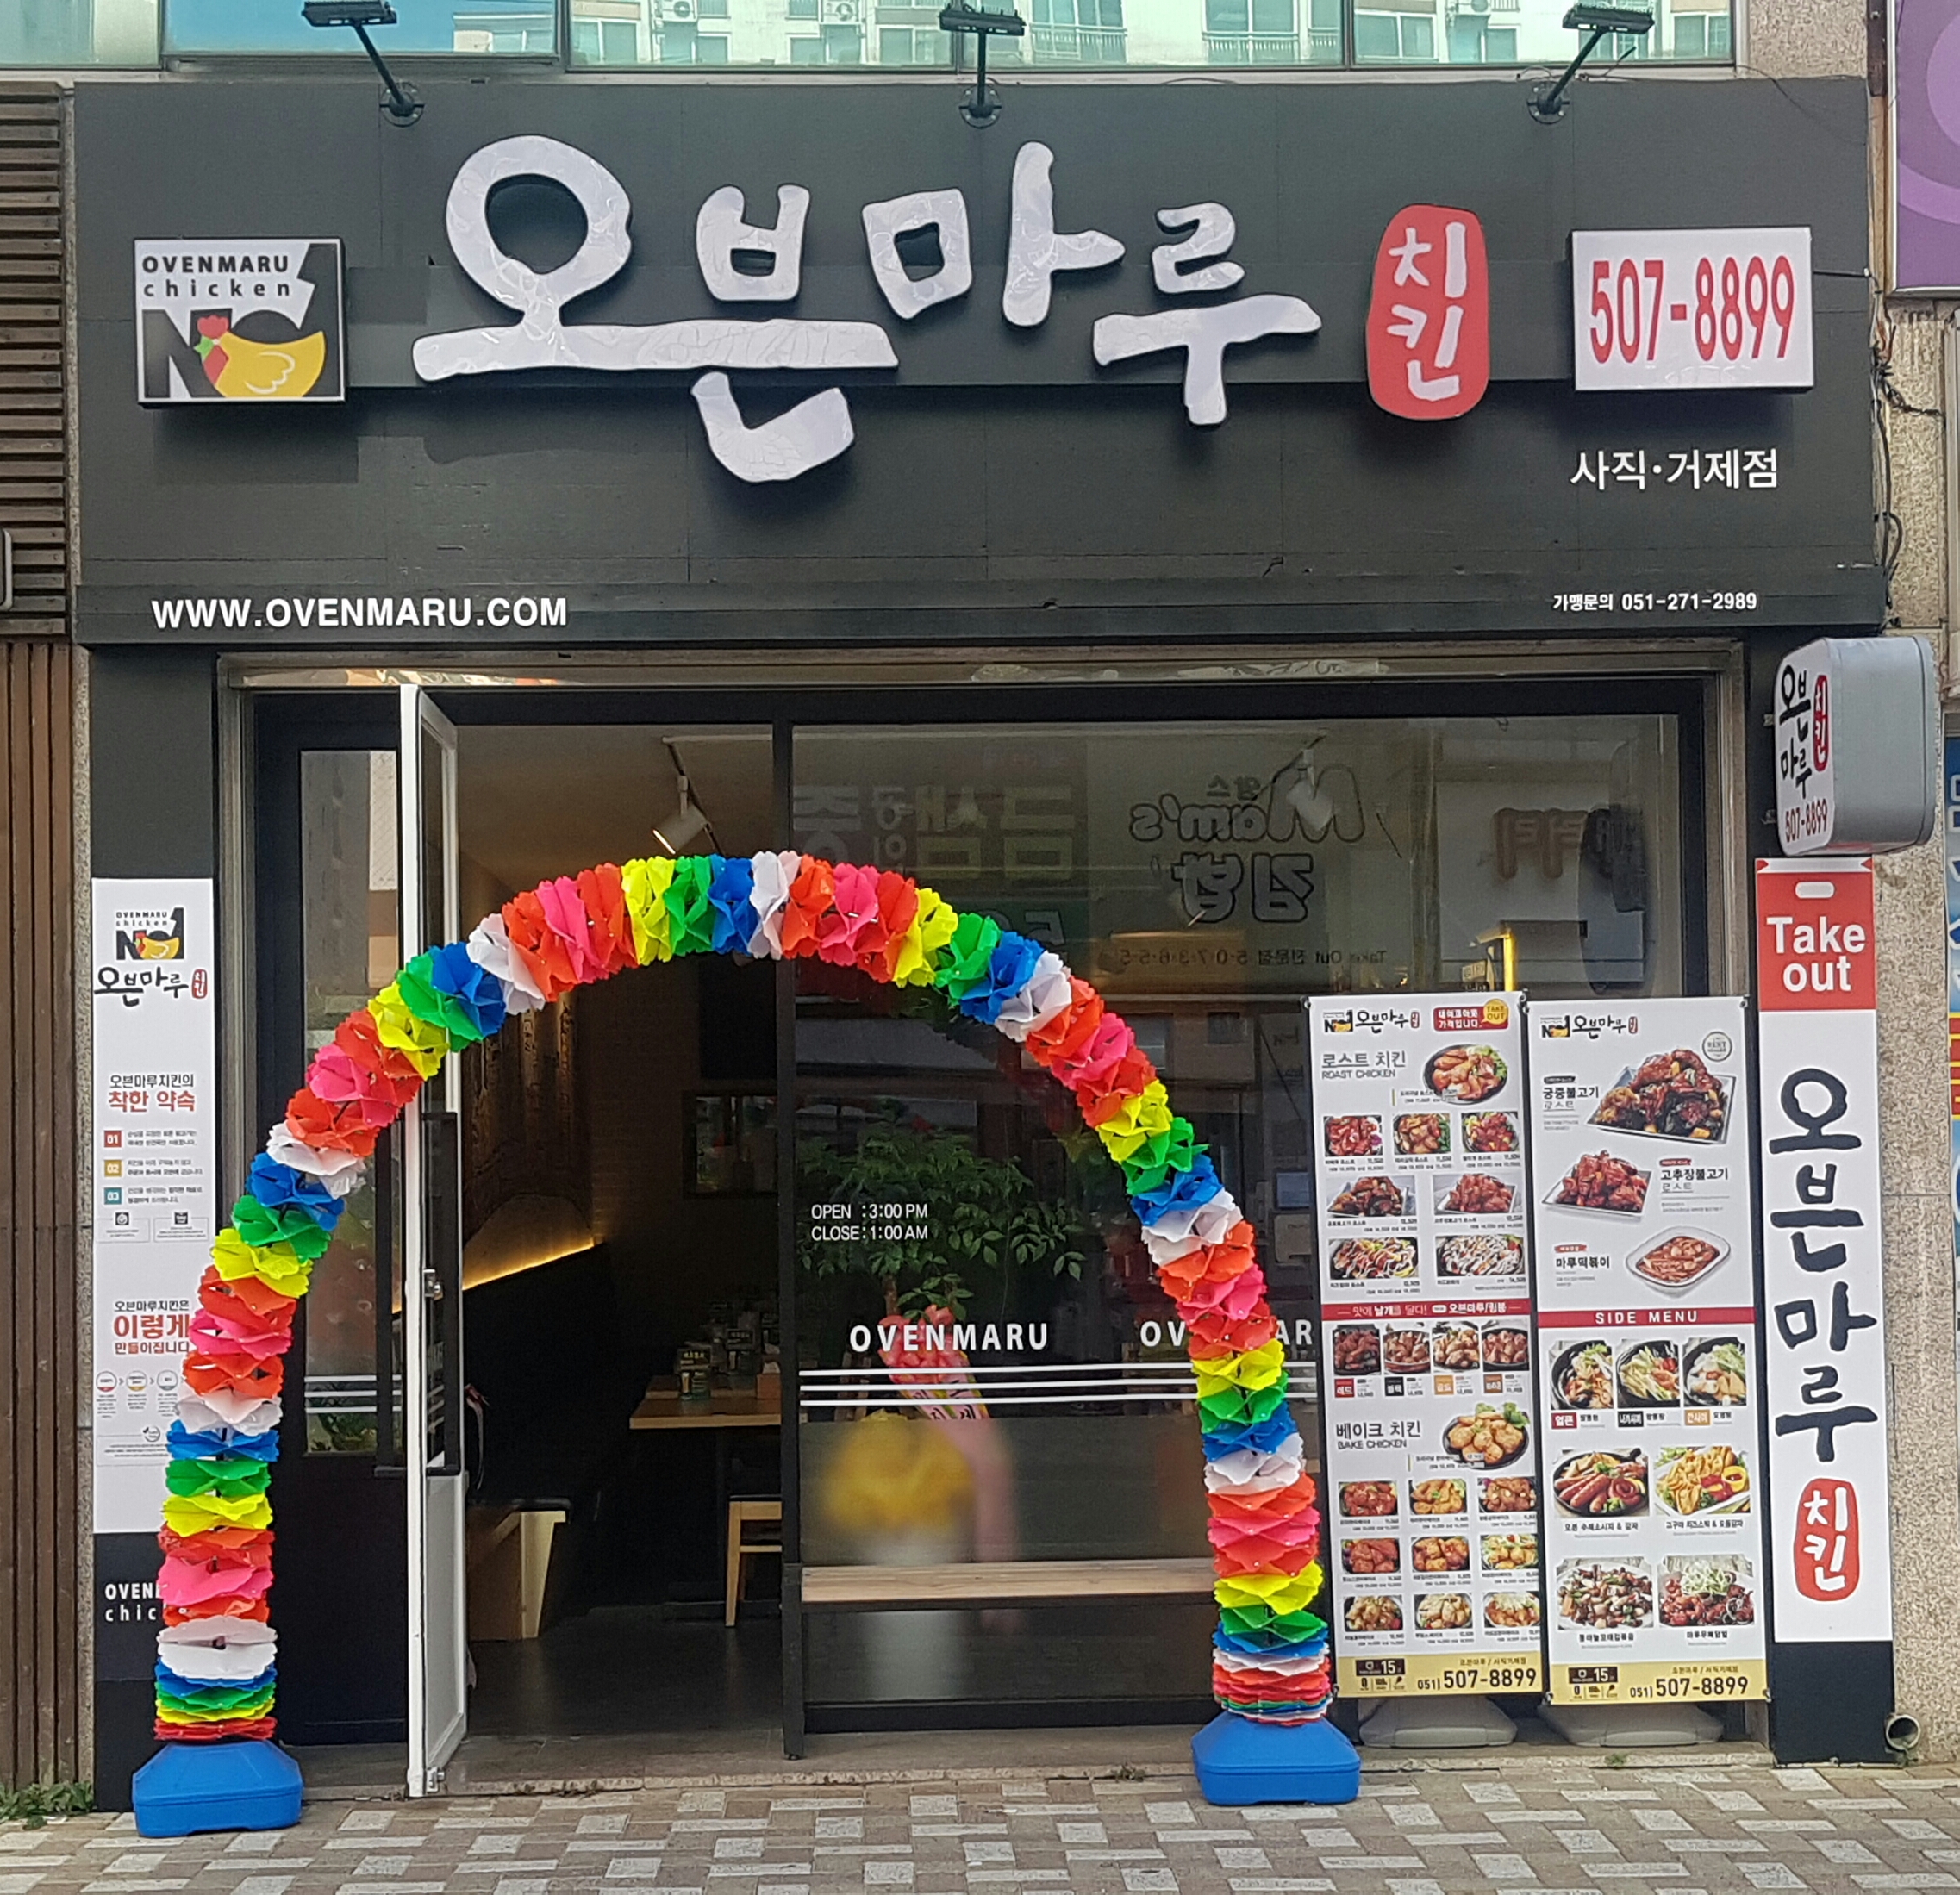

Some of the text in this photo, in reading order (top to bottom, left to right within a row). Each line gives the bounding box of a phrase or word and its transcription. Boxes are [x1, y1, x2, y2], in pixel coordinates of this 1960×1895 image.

[142, 255, 288, 273] OVENMARU
[143, 279, 290, 296] chicken
[413, 134, 1322, 483] 오븐마루
[1387, 221, 1466, 402] 치킨
[1589, 255, 1795, 363] 507-8899
[1570, 447, 1778, 491] 사직·거제점
[151, 597, 567, 629] WWW.OVENMARU.COM
[1552, 593, 1757, 613] 가맹문의 051-271-2989
[1784, 798, 1827, 844] 507-8899
[1766, 916, 1866, 955] Take
[1782, 956, 1851, 992] out
[94, 966, 189, 1007] 오븐마루
[1321, 1051, 1406, 1068] 로스트 치킨
[109, 1074, 194, 1088] 오븐마루치킨의
[1322, 1069, 1395, 1079] ROAST CHICKEN
[109, 1091, 195, 1113] 착한 약속
[107, 1134, 118, 1144] 01
[811, 1204, 852, 1219] OPEN
[905, 1203, 928, 1219] PM
[811, 1225, 859, 1241] CLOSE
[903, 1225, 928, 1240] AM
[1769, 1069, 1878, 1462] 오븐마루
[114, 1300, 190, 1312] 오븐마루치킨은
[114, 1314, 190, 1339] 이렇게
[1595, 1311, 1698, 1324] SIDE MENU
[849, 1322, 1048, 1352] OVENMARU
[1336, 1421, 1420, 1439] 베이크 치킨
[1338, 1441, 1363, 1449] BAKE
[1803, 1487, 1848, 1592] 치킨
[104, 1603, 167, 1621] chic
[1381, 1661, 1395, 1674] 15
[1595, 1668, 1608, 1682] 15
[1418, 1668, 1537, 1690] 051) 507-8899
[1630, 1676, 1748, 1698] 051) 507-8899
